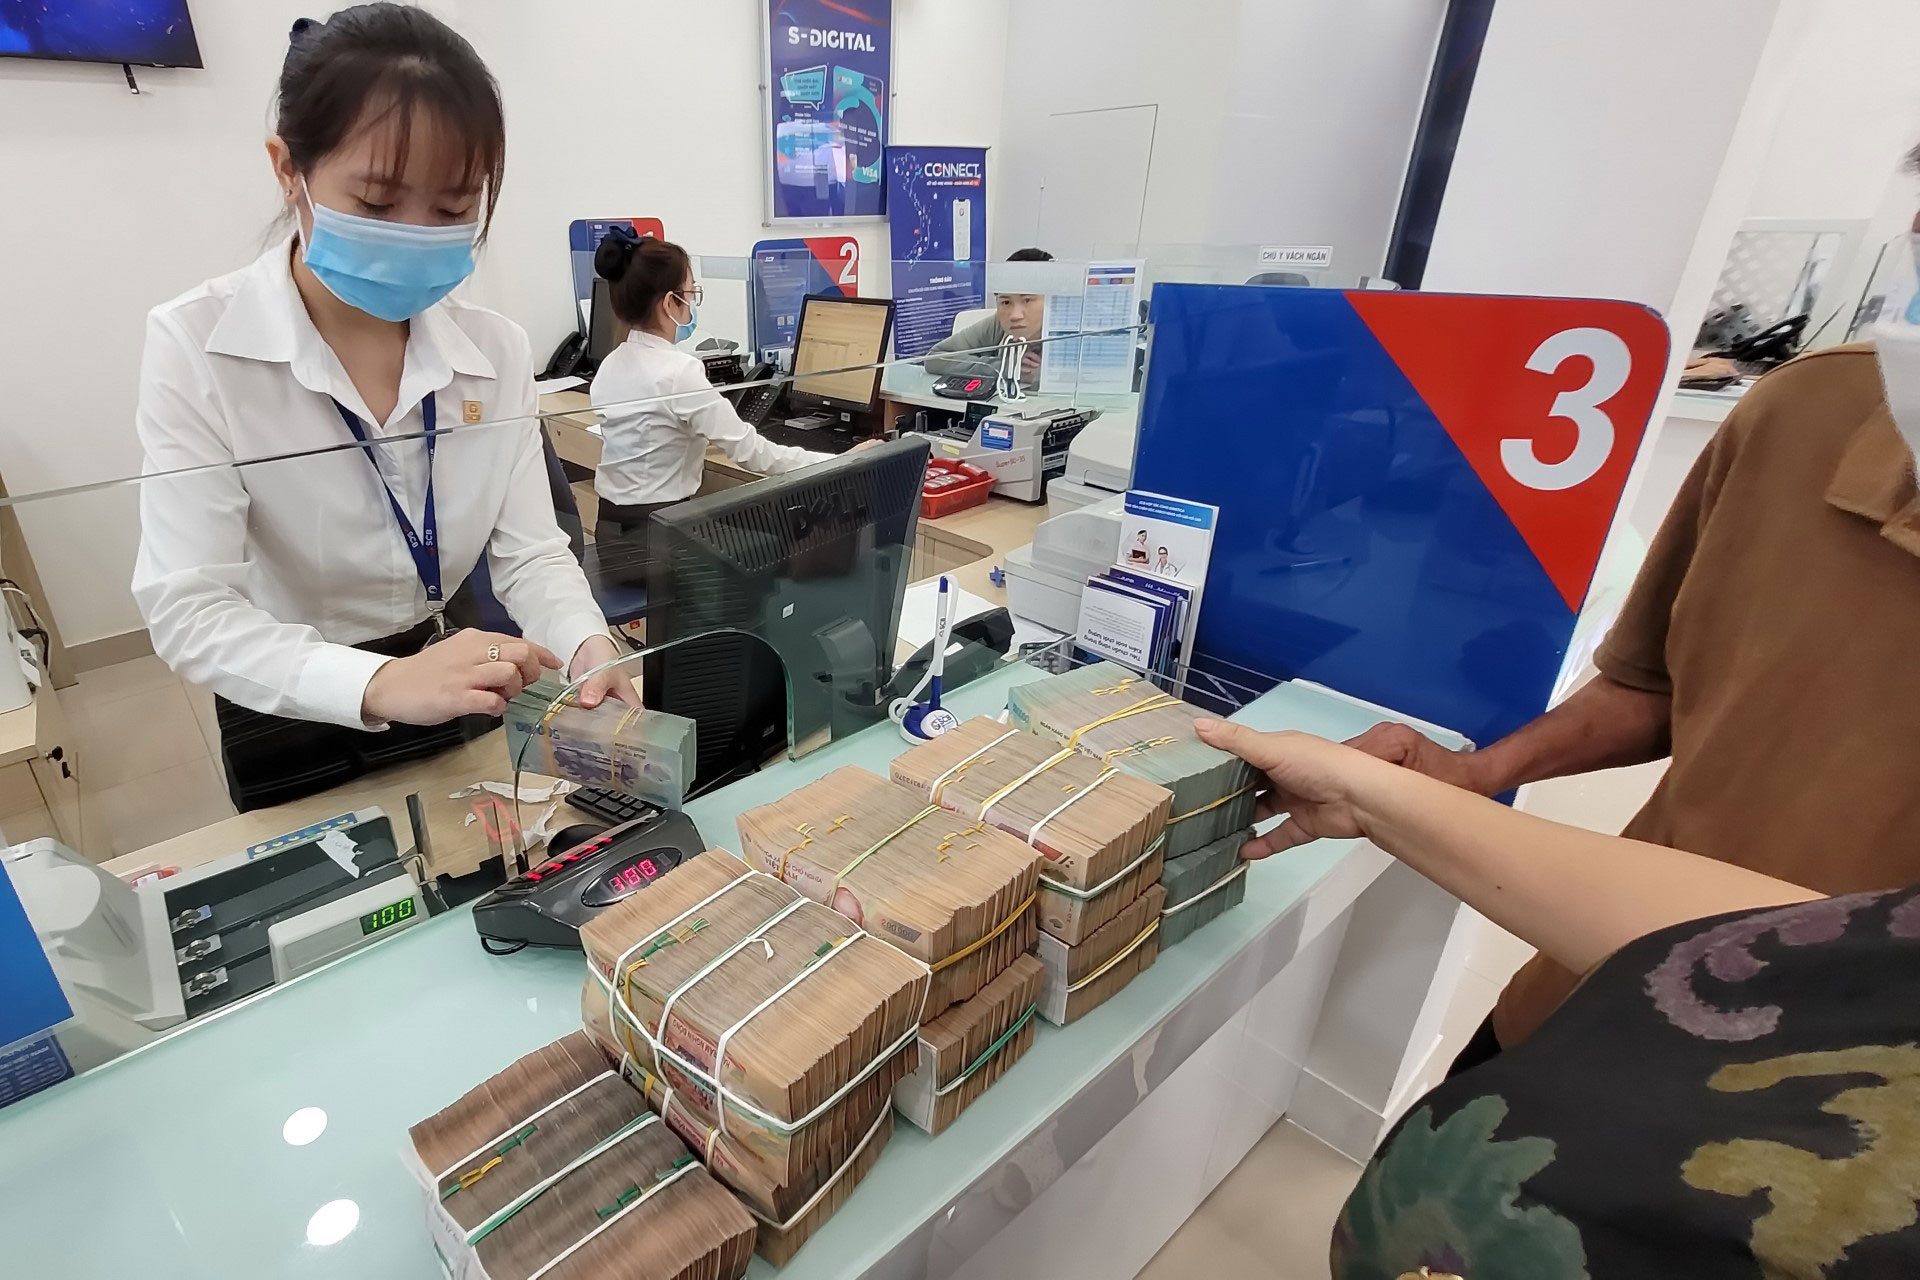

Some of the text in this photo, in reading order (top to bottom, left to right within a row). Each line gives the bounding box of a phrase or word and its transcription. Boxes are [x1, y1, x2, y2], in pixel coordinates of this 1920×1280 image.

[788, 26, 876, 52] S-DIGITAL
[862, 166, 879, 179] VISA
[924, 162, 981, 178] CONNECT
[839, 242, 858, 285] 2
[1500, 327, 1632, 491] 3
[372, 899, 412, 928] 100
